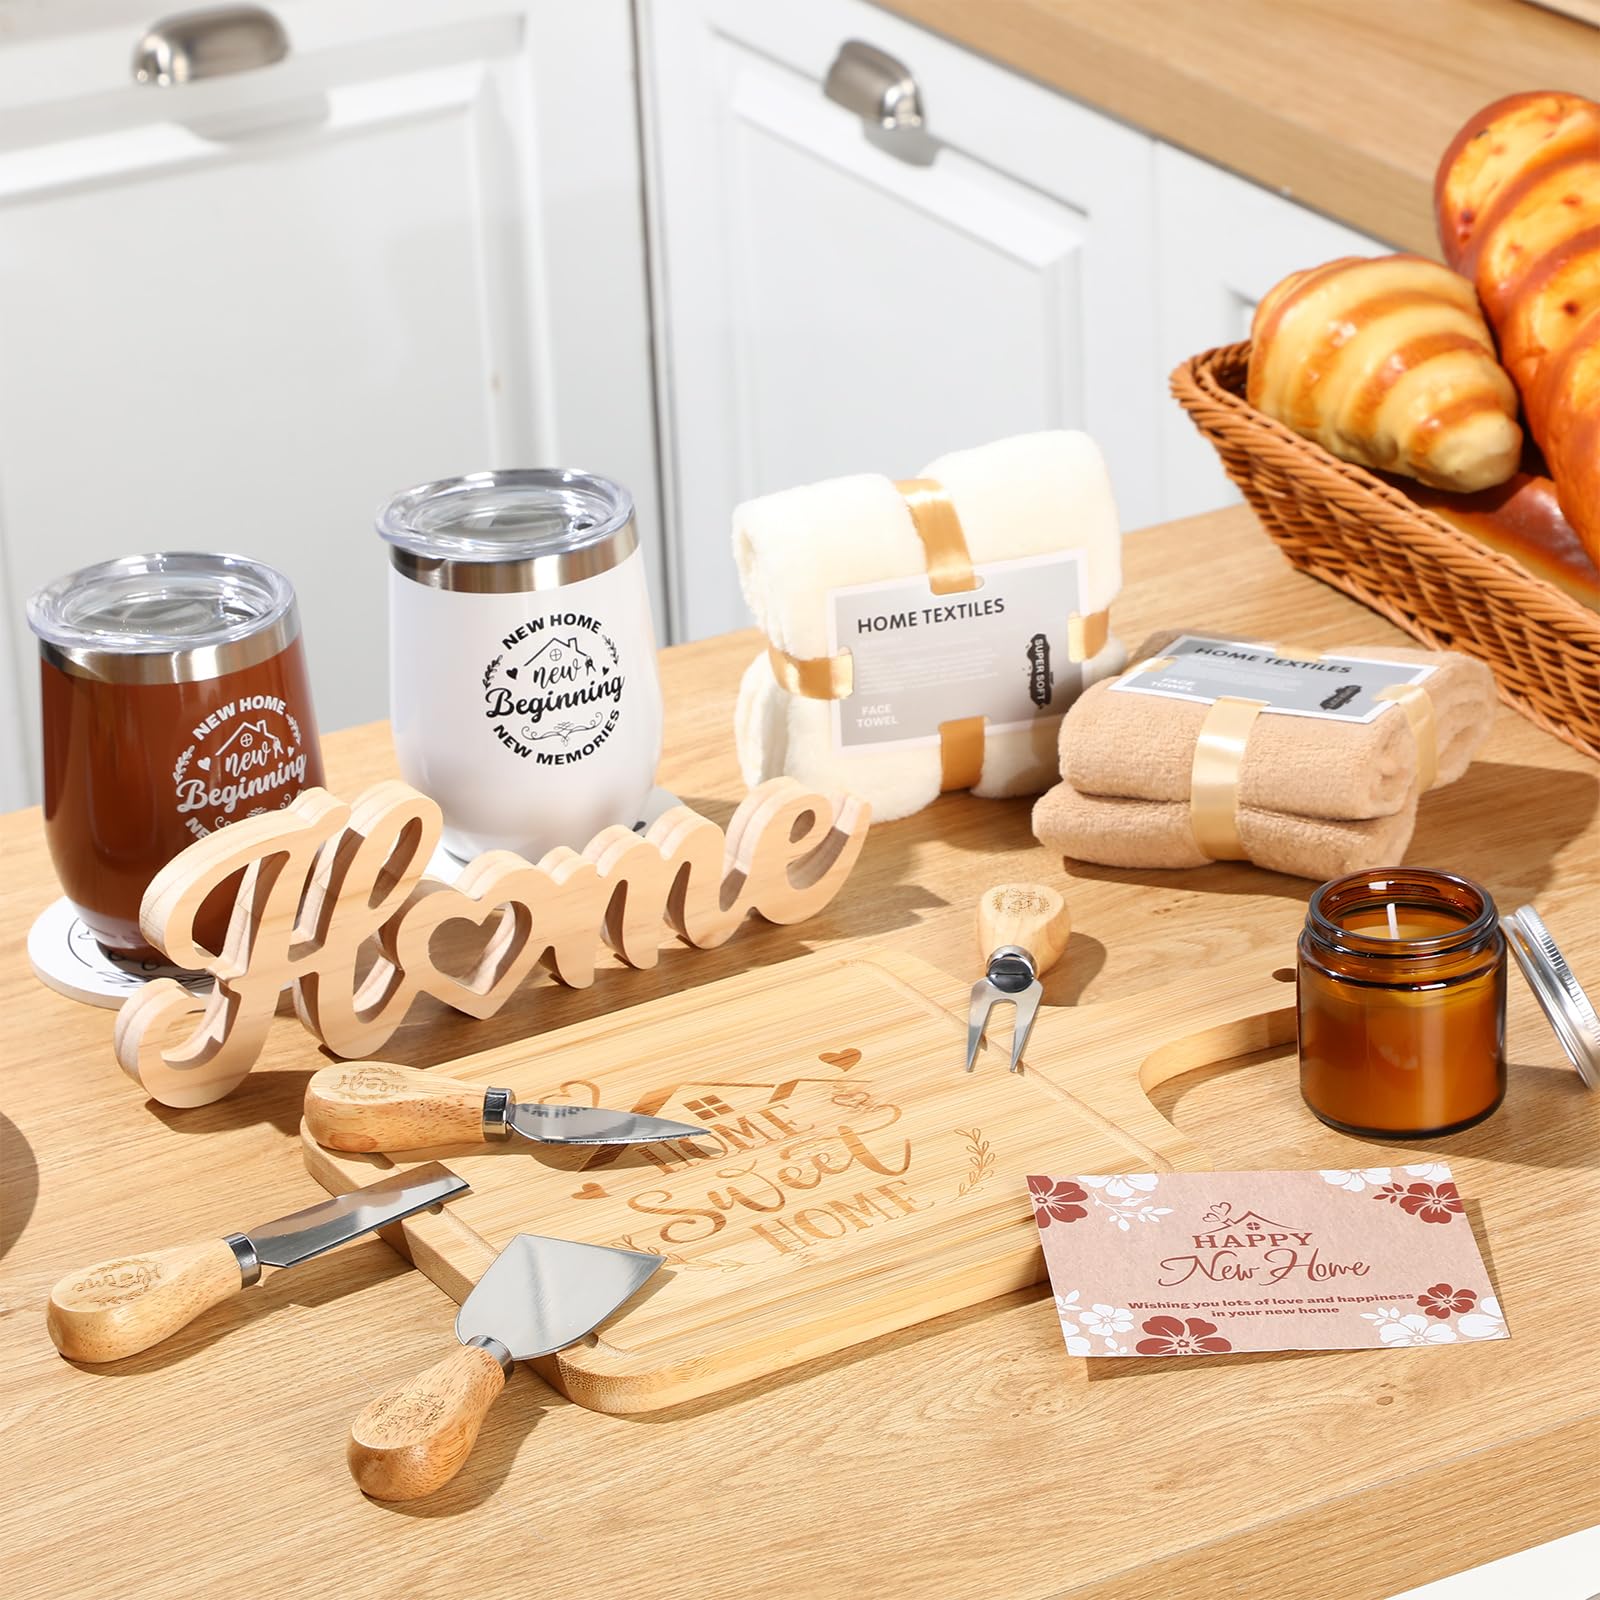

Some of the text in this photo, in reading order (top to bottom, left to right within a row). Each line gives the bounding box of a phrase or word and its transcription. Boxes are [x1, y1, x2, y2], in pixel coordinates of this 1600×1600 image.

[502, 613, 602, 650] NEW HOME
[857, 598, 1006, 634] HOME TEXTILES
[533, 658, 582, 689] new
[1034, 638, 1046, 701] SUPER SOFT
[1194, 647, 1353, 674] HOME TEXTILES
[192, 695, 287, 740] NEW HOME
[485, 675, 625, 723] Beginning
[861, 703, 893, 715] FACE
[493, 709, 620, 765] NEW MEMORIES
[856, 715, 899, 729] TOWEL
[225, 741, 271, 777] new
[175, 754, 307, 813] Beginning
[185, 816, 211, 840] NE
[114, 776, 873, 1109] Home
[633, 1104, 816, 1176] HOME
[627, 1103, 912, 1244] Sweet
[751, 1180, 936, 1255] HOME
[1191, 1231, 1314, 1250] HAPPY
[1157, 1247, 1371, 1288] New Home
[1128, 1292, 1415, 1310] Wishing you lots of love and happiness
[1211, 1306, 1340, 1318] in your new home
